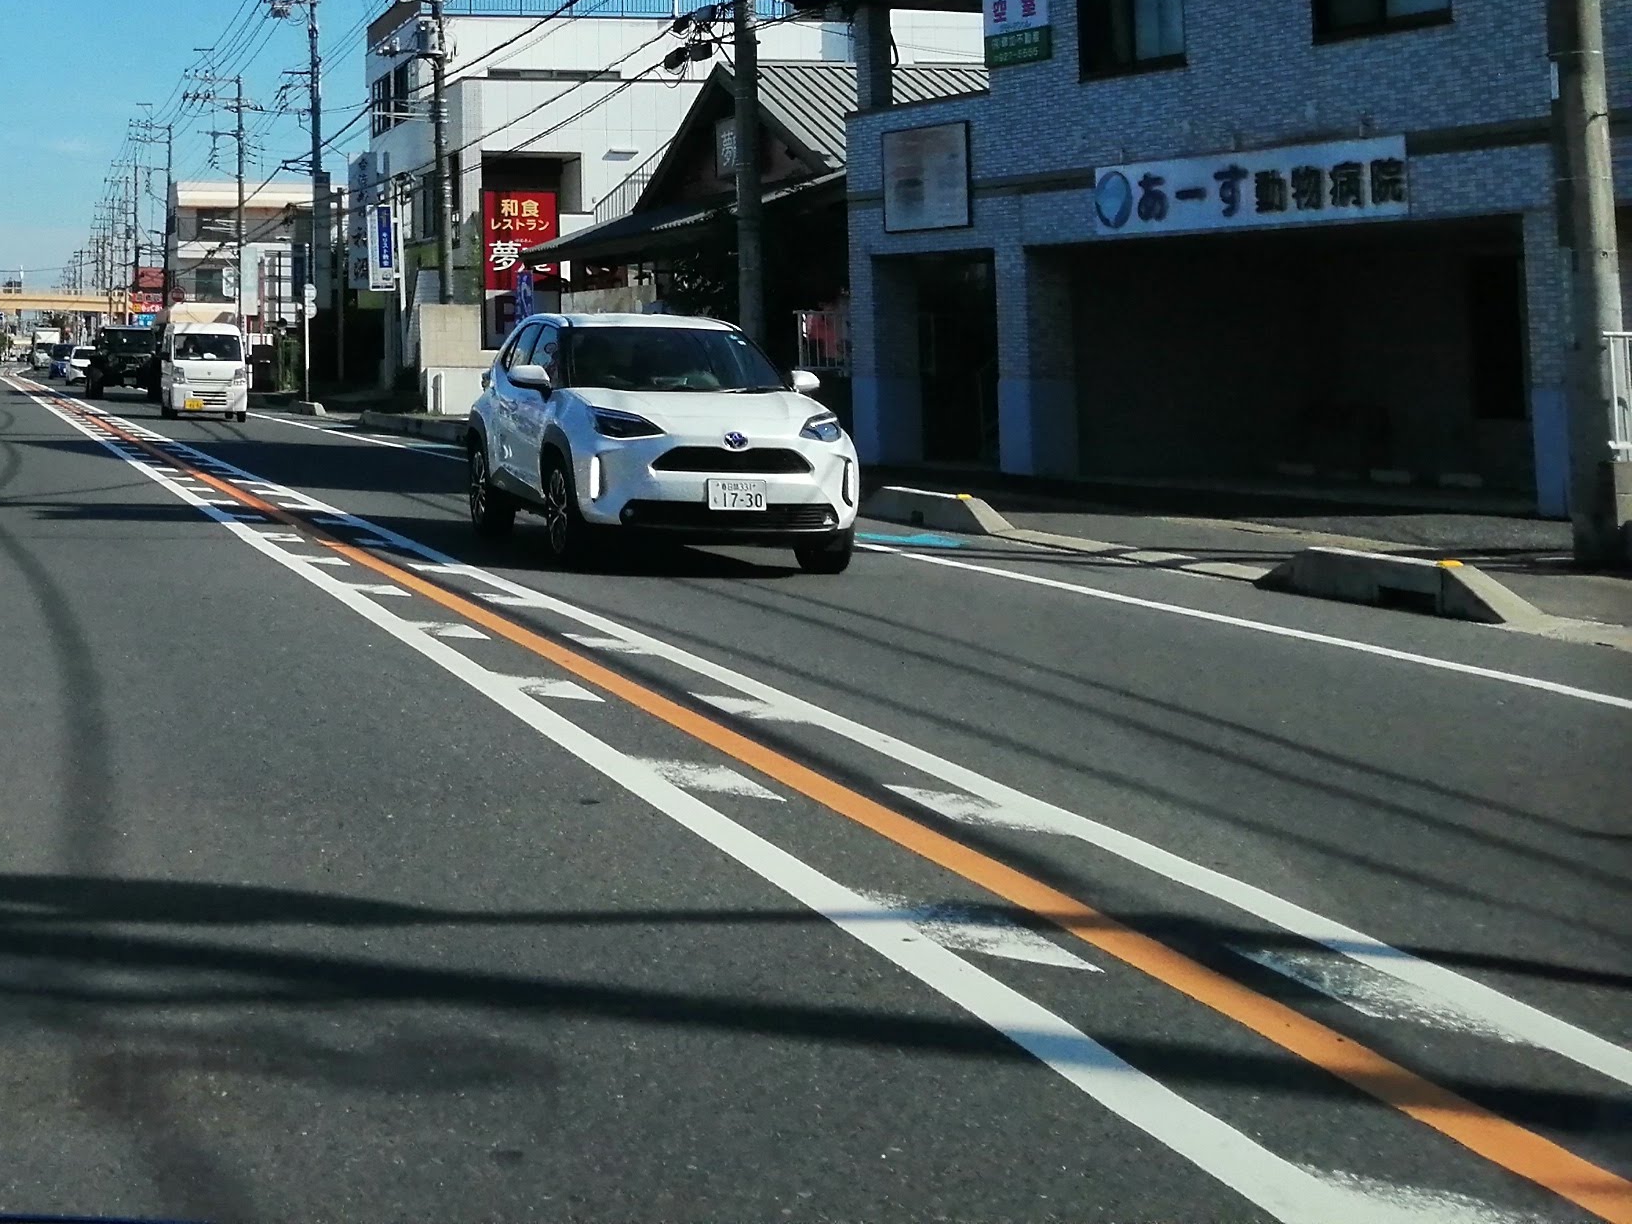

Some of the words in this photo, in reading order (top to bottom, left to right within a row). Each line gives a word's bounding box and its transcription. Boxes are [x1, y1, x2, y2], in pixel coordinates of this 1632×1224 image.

[500, 199, 540, 218] 和食
[490, 218, 550, 231] レストラン
[723, 492, 763, 508] 17-30
